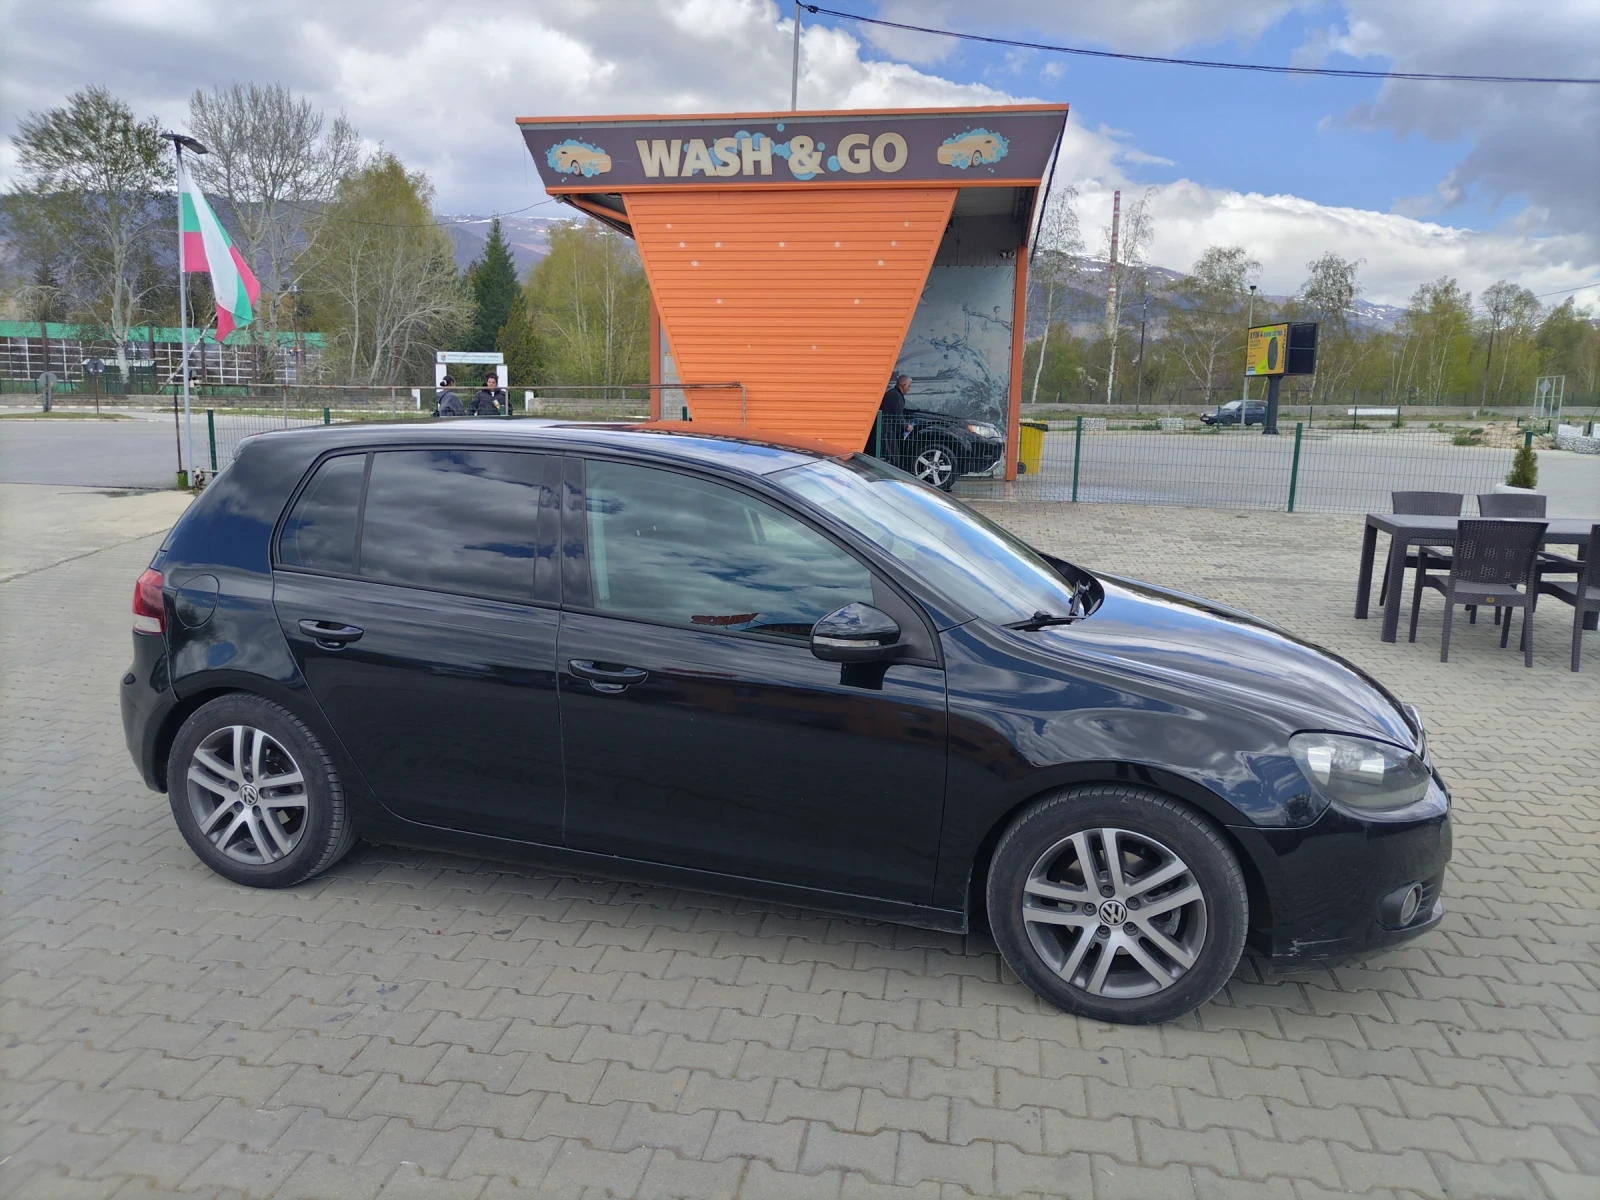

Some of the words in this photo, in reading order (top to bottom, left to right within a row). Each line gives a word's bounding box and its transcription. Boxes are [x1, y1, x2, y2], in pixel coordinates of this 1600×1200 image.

[636, 137, 773, 177] WASH
[788, 135, 826, 175] &
[837, 132, 908, 174] GO
